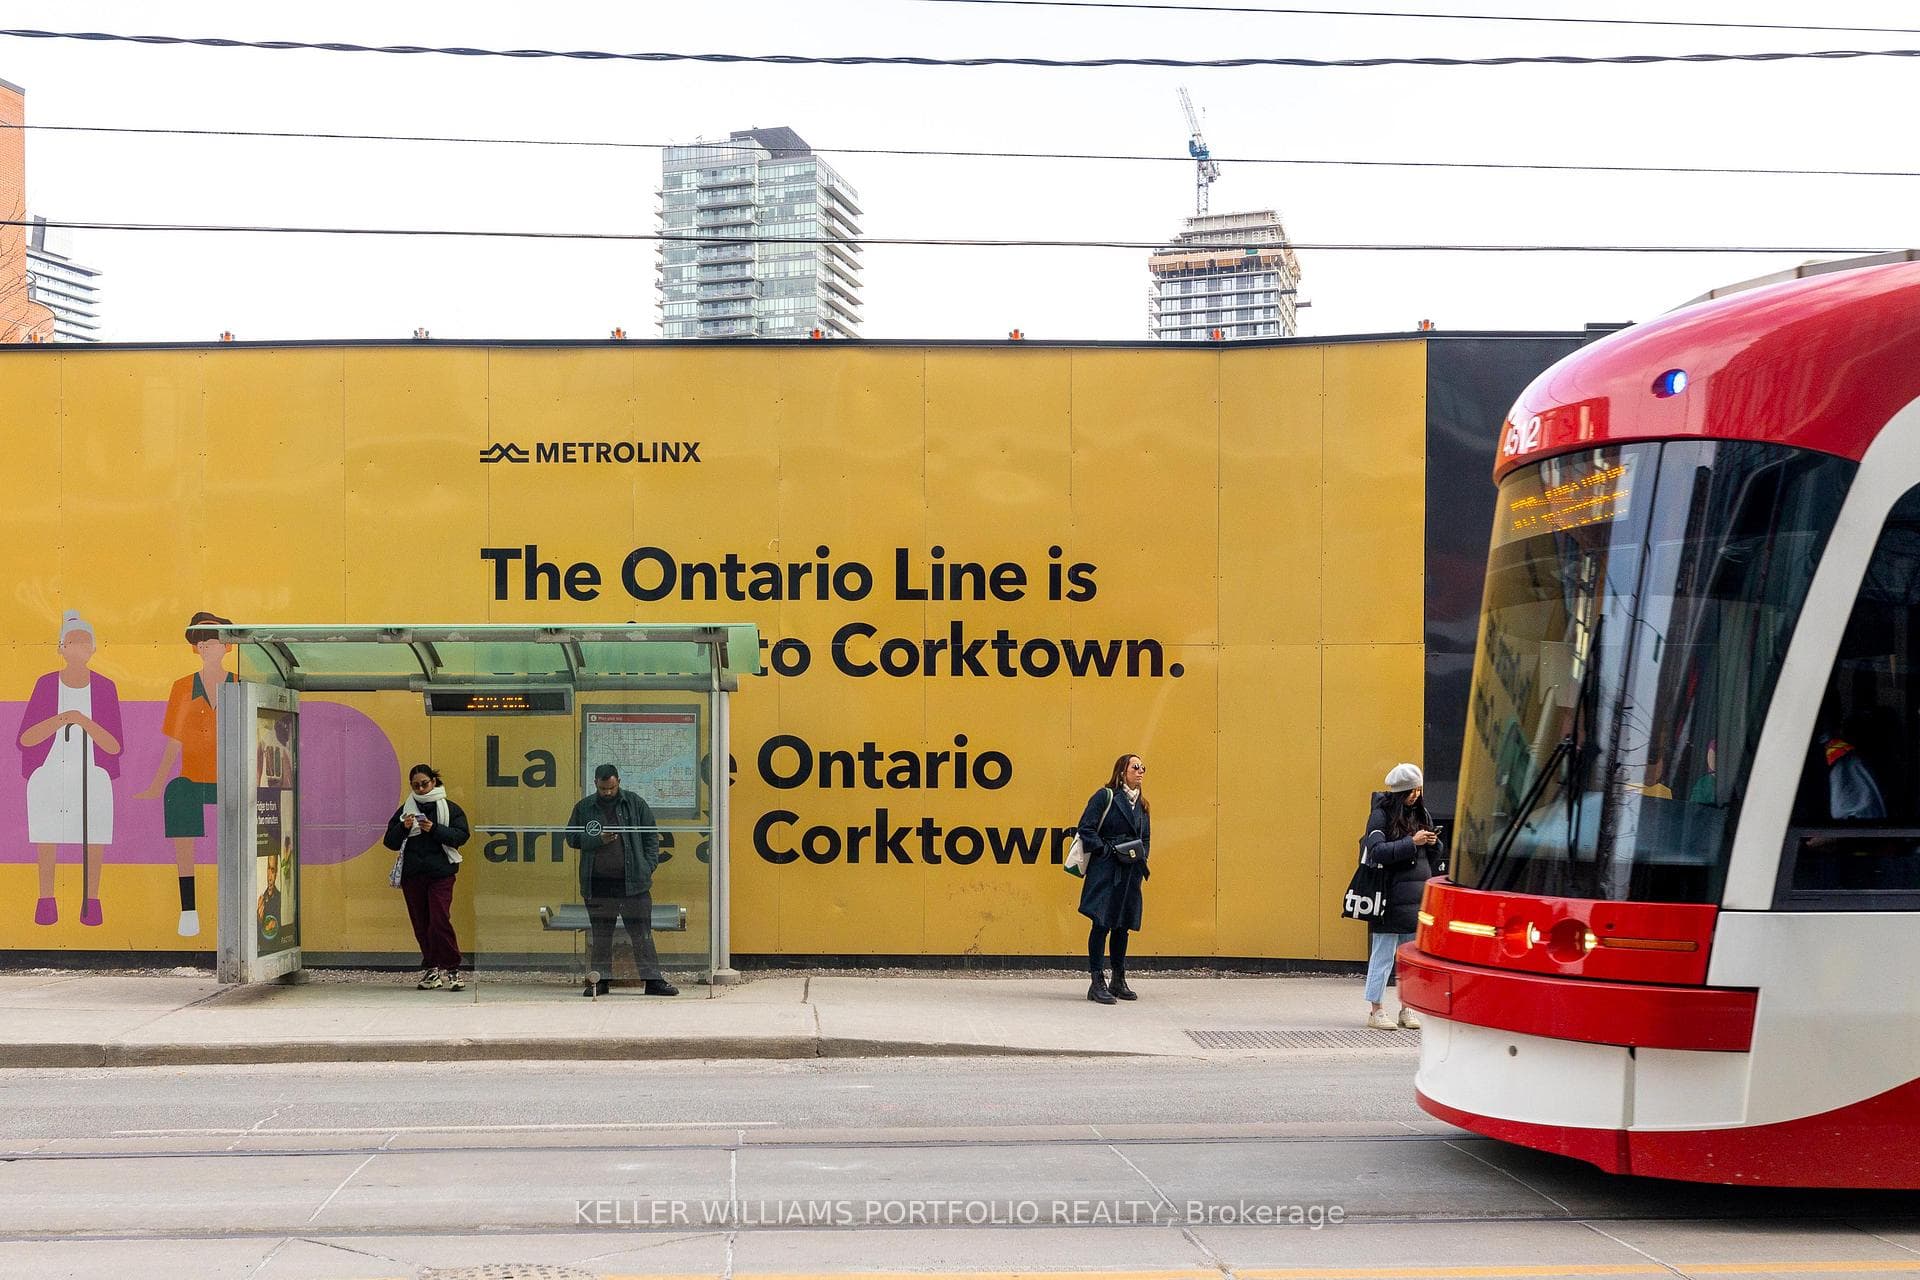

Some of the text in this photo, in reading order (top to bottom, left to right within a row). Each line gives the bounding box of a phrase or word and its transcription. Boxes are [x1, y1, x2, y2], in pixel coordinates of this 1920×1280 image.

[536, 442, 701, 463] METROLINX
[481, 546, 1097, 602] The Ontario Line is
[832, 622, 1185, 678] Corktown.
[487, 736, 557, 788] La
[757, 735, 1013, 789] Ontario
